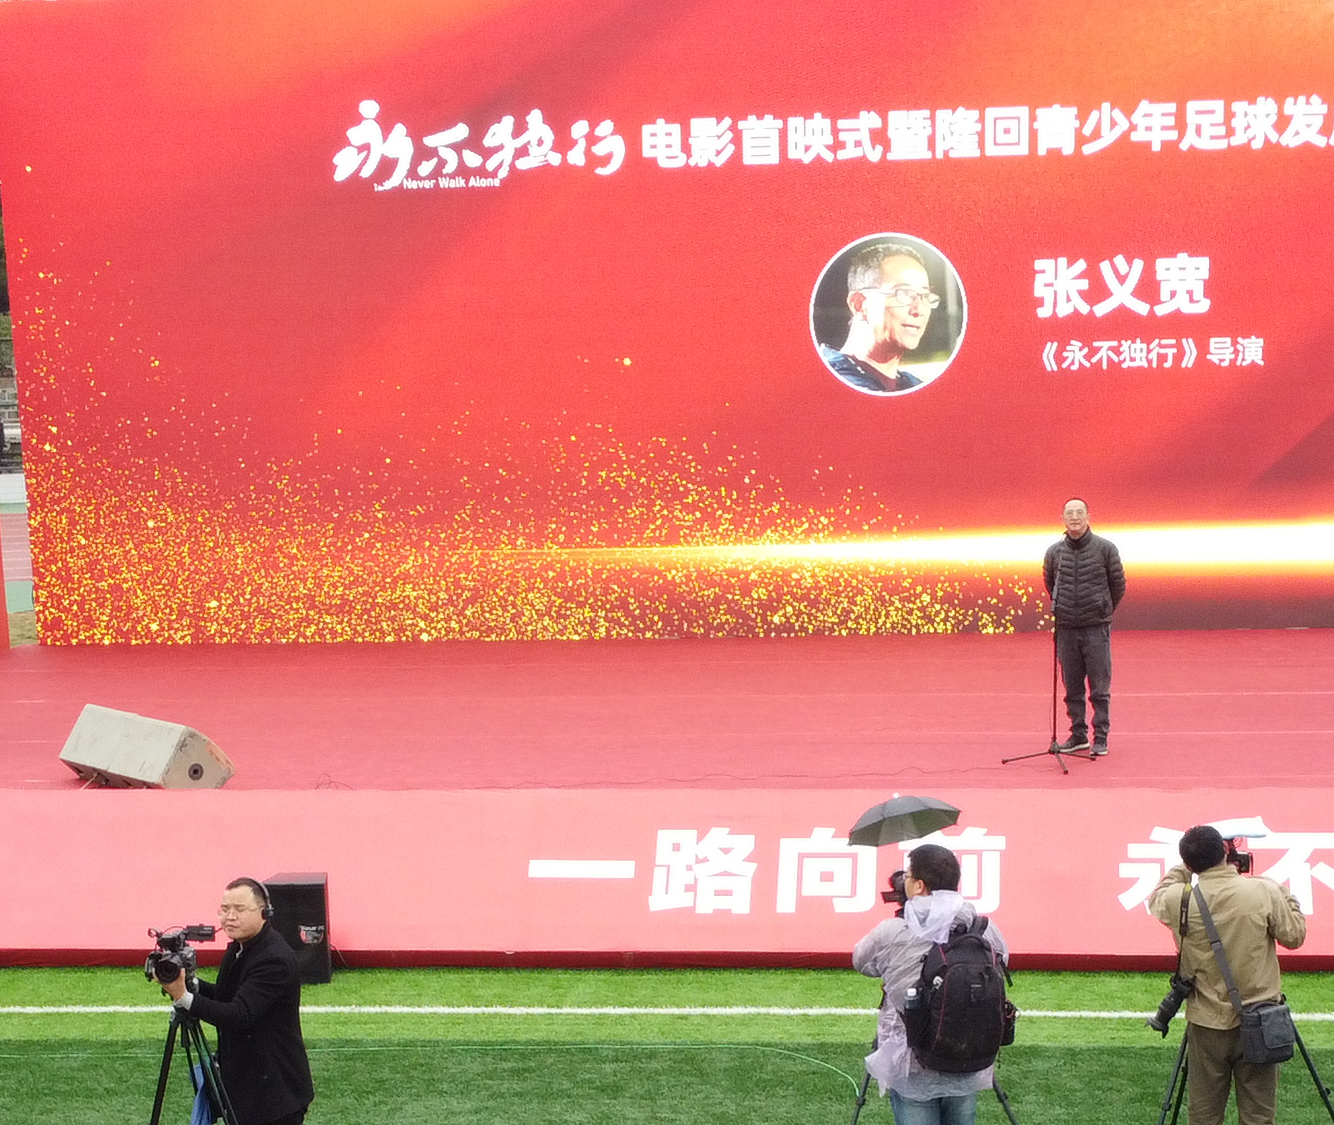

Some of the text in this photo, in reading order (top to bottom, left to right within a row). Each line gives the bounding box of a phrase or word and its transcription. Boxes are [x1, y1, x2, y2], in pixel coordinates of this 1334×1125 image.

[333, 100, 625, 188] 永不独行
[403, 175, 501, 189] Never Walk Alone
[1034, 253, 1211, 317] 张义宽
[1043, 337, 1264, 372] 《永不独行》导演
